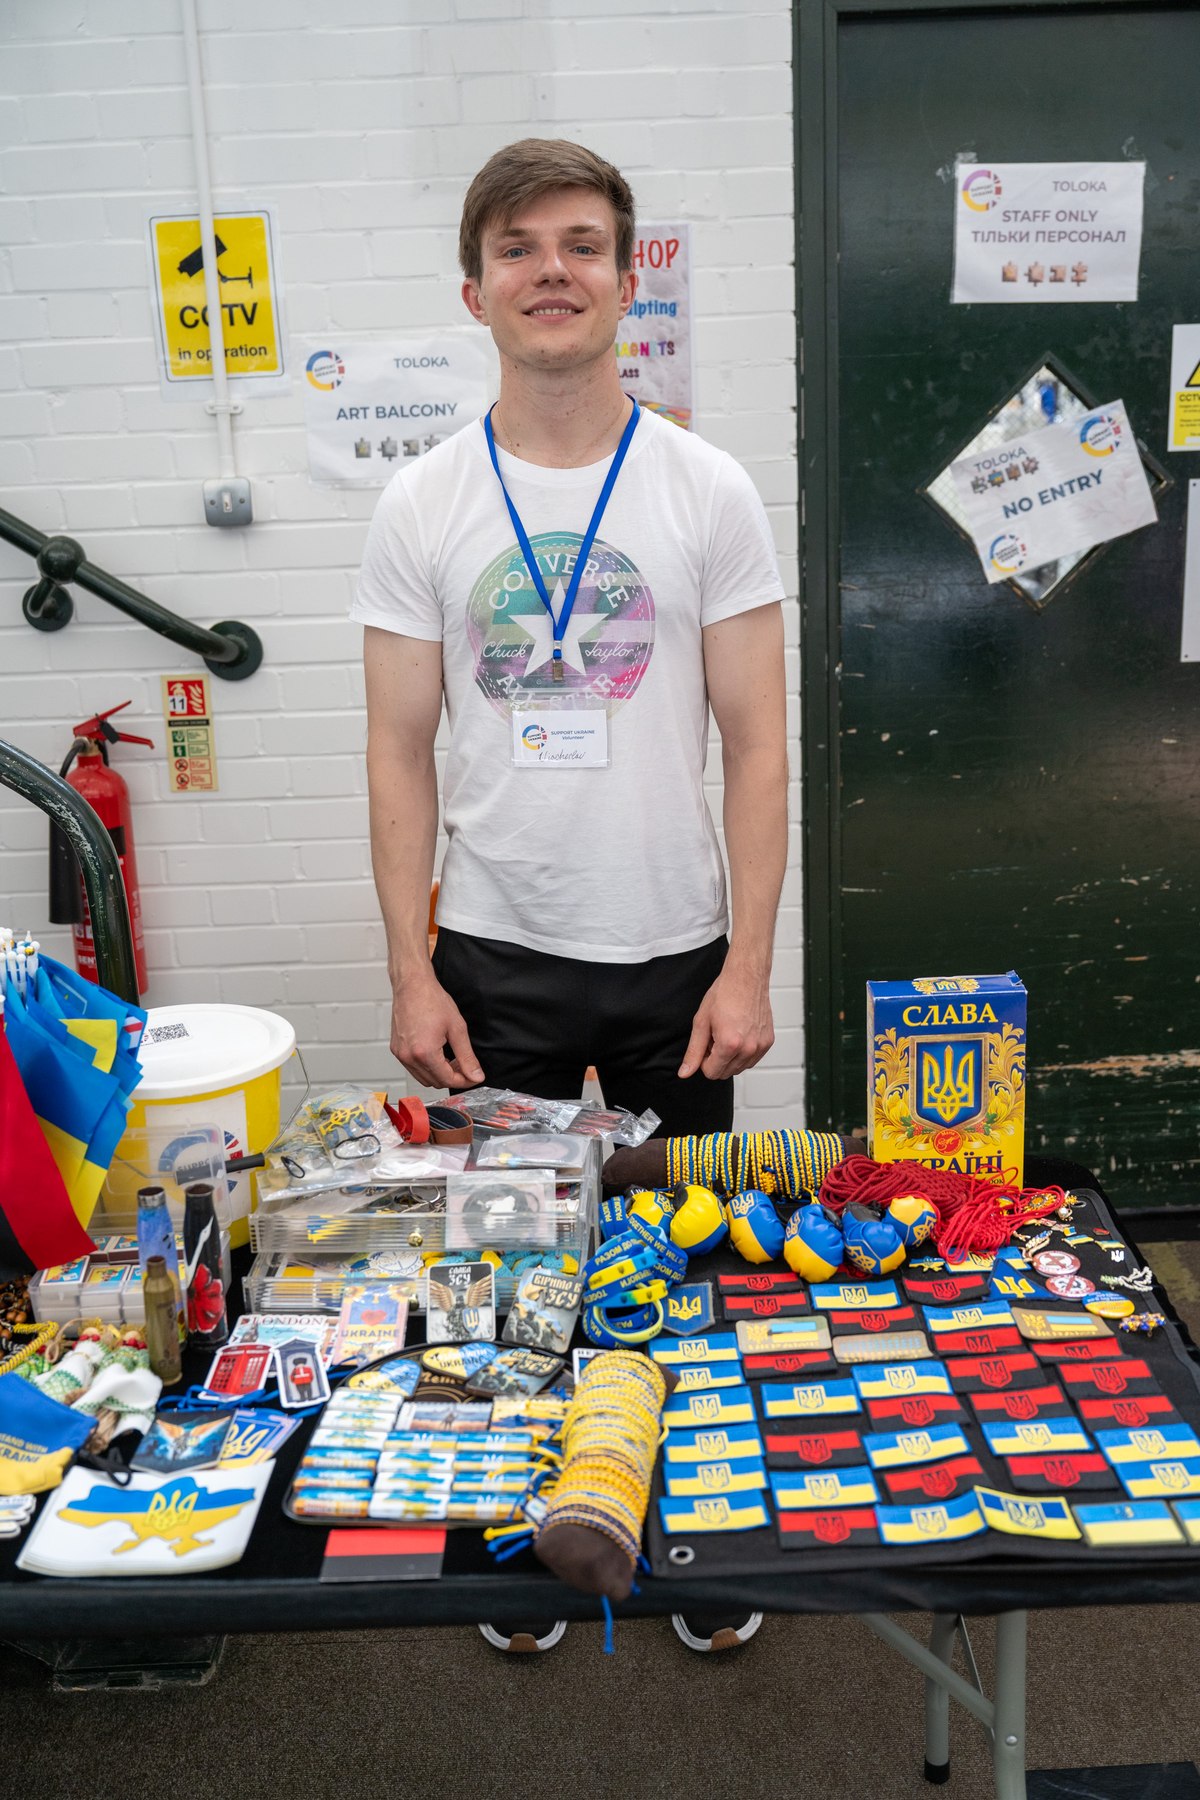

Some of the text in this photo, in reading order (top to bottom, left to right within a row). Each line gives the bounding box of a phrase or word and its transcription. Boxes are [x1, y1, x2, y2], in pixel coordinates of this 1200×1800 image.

[1053, 180, 1107, 192] TOLOKA
[1002, 209, 1099, 222] STAFF ONLY
[971, 230, 1126, 243] ТІЛЬКИ ПЕРСОНАЛ
[178, 345, 268, 361] in opration
[393, 356, 450, 369] TOLOKA
[336, 403, 458, 421] ART BALCONY
[974, 446, 1028, 473] TOLOKA
[1002, 469, 1104, 519] NO ENTRY
[482, 638, 530, 659] Chuck
[169, 697, 185, 711] 11
[902, 1003, 998, 1027] СЛАВА
[891, 1150, 1004, 1175] РАЇНІ
[595, 1244, 622, 1265] РАЗОМ
[448, 1274, 471, 1286] ЗСУ
[545, 1290, 579, 1309] ЗСУ
[251, 1316, 324, 1326] LONDON
[340, 1329, 400, 1338] UKRAINE
